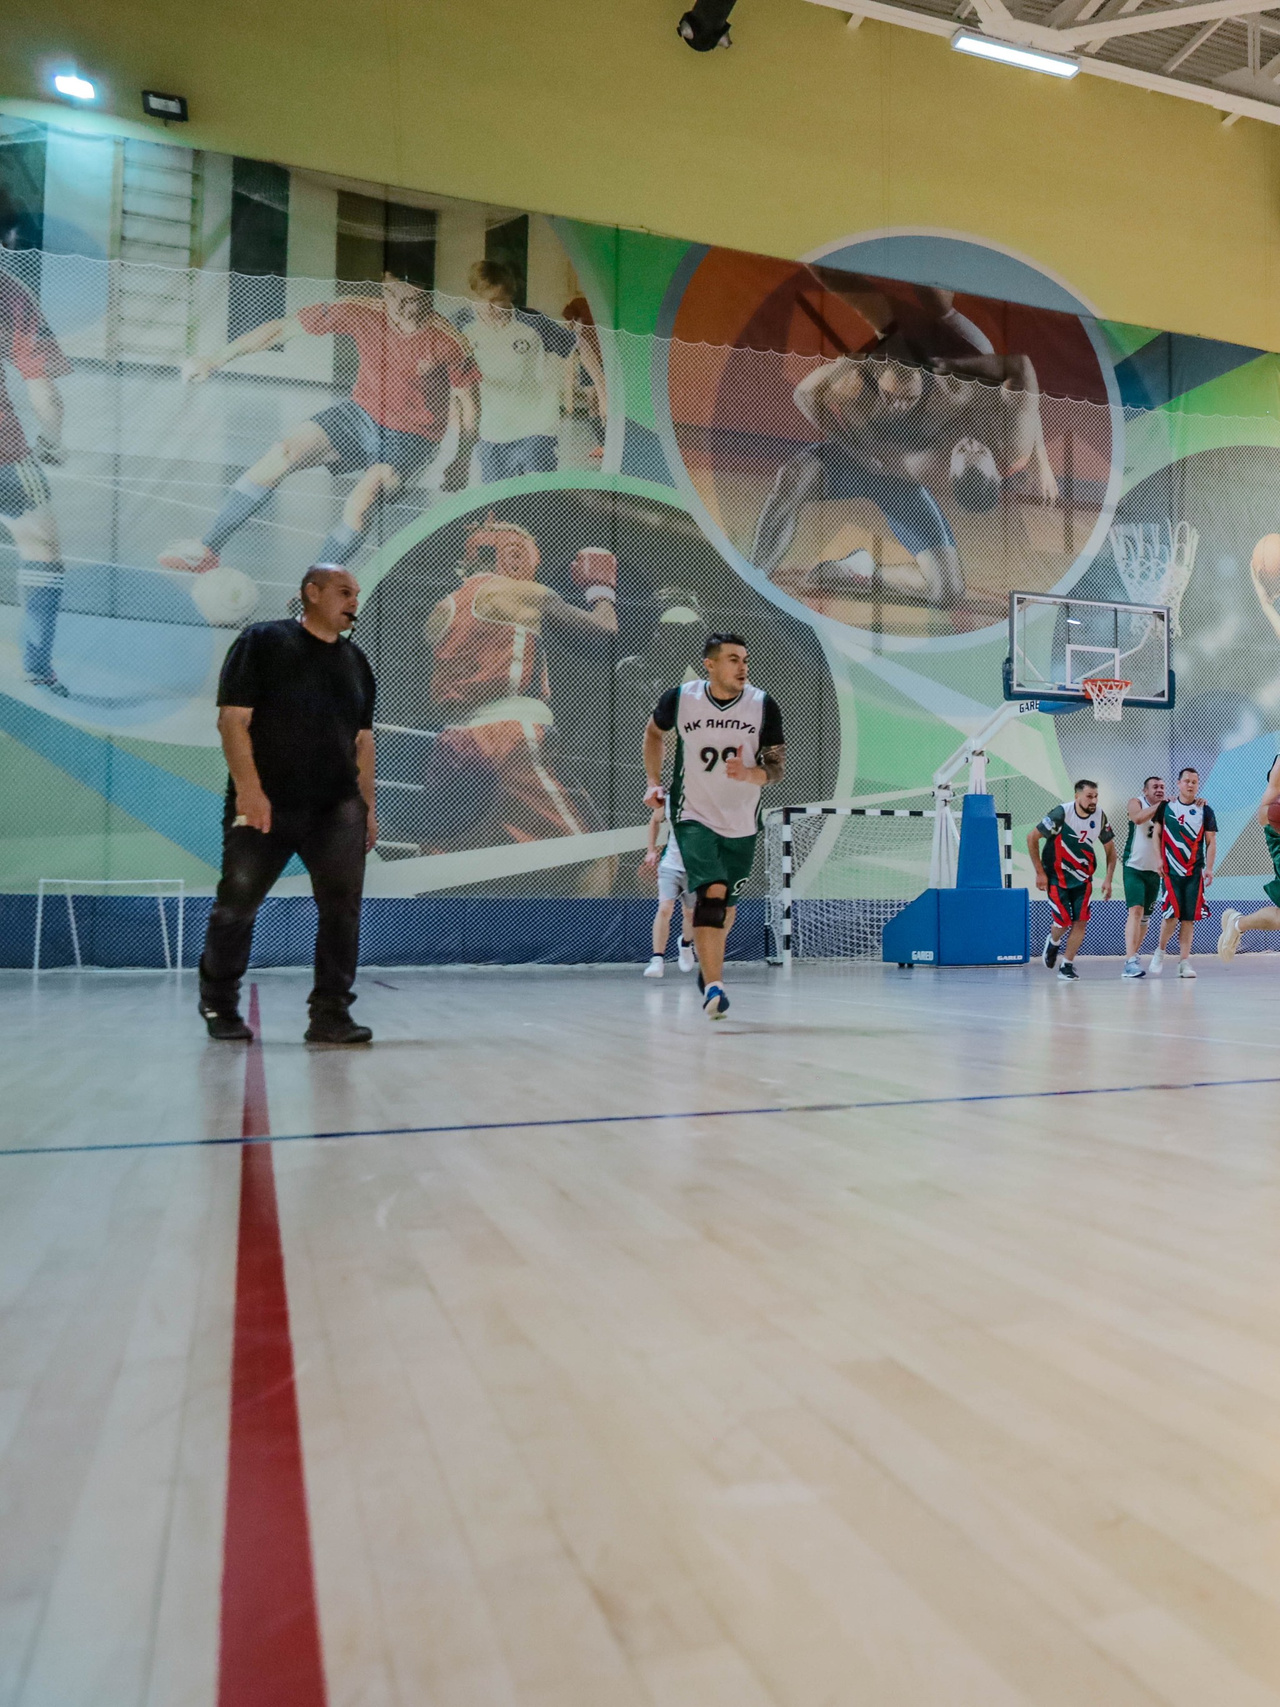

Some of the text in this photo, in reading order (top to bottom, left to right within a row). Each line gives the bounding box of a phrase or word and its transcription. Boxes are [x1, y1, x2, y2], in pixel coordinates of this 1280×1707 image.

[1019, 700, 1040, 713] GARE
[684, 719, 701, 733] НК
[1177, 814, 1185, 825] 4
[1078, 830, 1088, 843] 7
